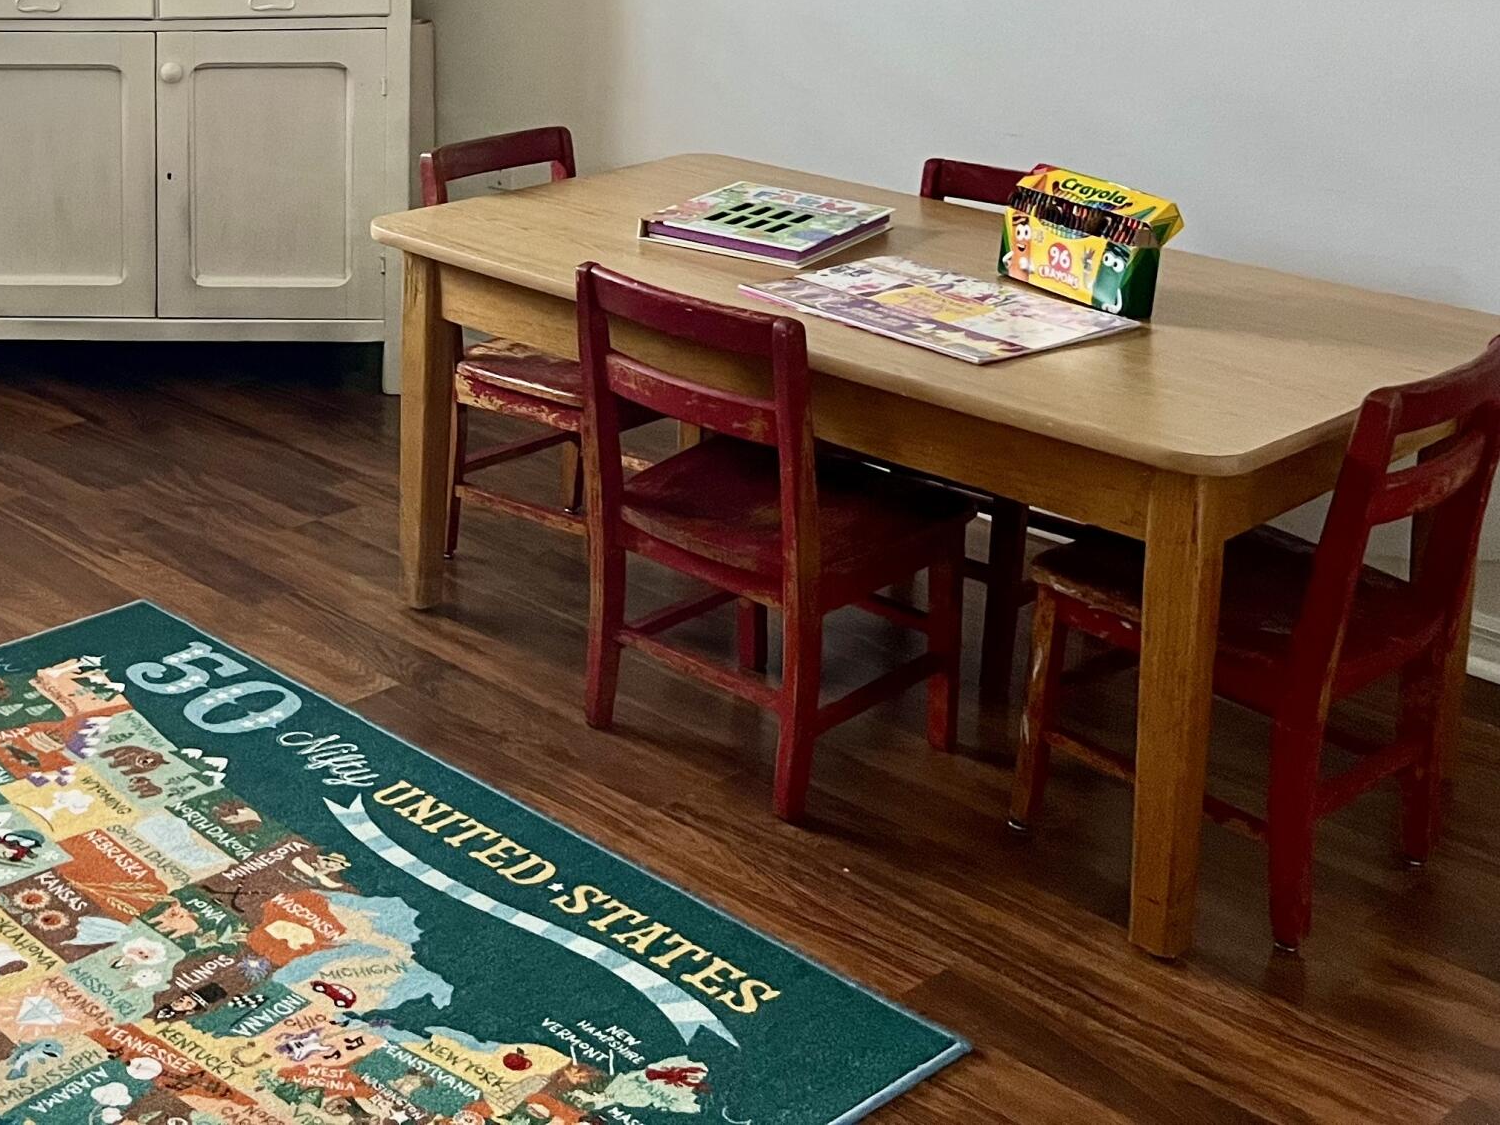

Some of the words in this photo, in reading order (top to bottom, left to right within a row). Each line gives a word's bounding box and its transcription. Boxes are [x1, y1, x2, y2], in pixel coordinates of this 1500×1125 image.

[1061, 178, 1129, 205] Crayola
[1038, 264, 1080, 290] CRAYONS
[1049, 246, 1071, 270] 96
[80, 776, 133, 815] WYOMING
[126, 641, 302, 734] 50
[276, 731, 380, 787] Nifty
[372, 779, 557, 886] UNITED
[550, 884, 781, 1014] STATES
[172, 801, 211, 837] NORTH
[207, 824, 254, 861] DAKOTA
[83, 830, 148, 881] NEBRASKA
[106, 823, 149, 857] SOUTH
[147, 850, 191, 886] DAKOTA
[222, 841, 311, 881] MINNESOTA
[34, 870, 88, 912] KANSAS
[185, 898, 228, 925] IOWA
[270, 892, 343, 941] WISCONSIN
[68, 965, 137, 1018] MISSOURI
[173, 954, 235, 991] ILLINOIS
[319, 961, 408, 981] MICHIGAN
[43, 975, 117, 1027] ARKANSAS
[230, 992, 307, 1036] INDIANA
[283, 1013, 327, 1029] OHIO
[104, 1025, 198, 1073] TENNESSEE
[156, 1025, 243, 1080] KENTUCKY
[541, 1018, 609, 1062] VERMONT
[576, 1020, 646, 1065] HAMPSHIRE
[605, 1025, 642, 1046] NEW
[292, 1076, 356, 1092] VIRGINIA
[307, 1065, 348, 1078] WEST
[379, 1040, 482, 1100] PENNSYLVANIA
[423, 1041, 462, 1065] NEW
[463, 1060, 514, 1092] YORK
[29, 1066, 110, 1113] ALABAMA
